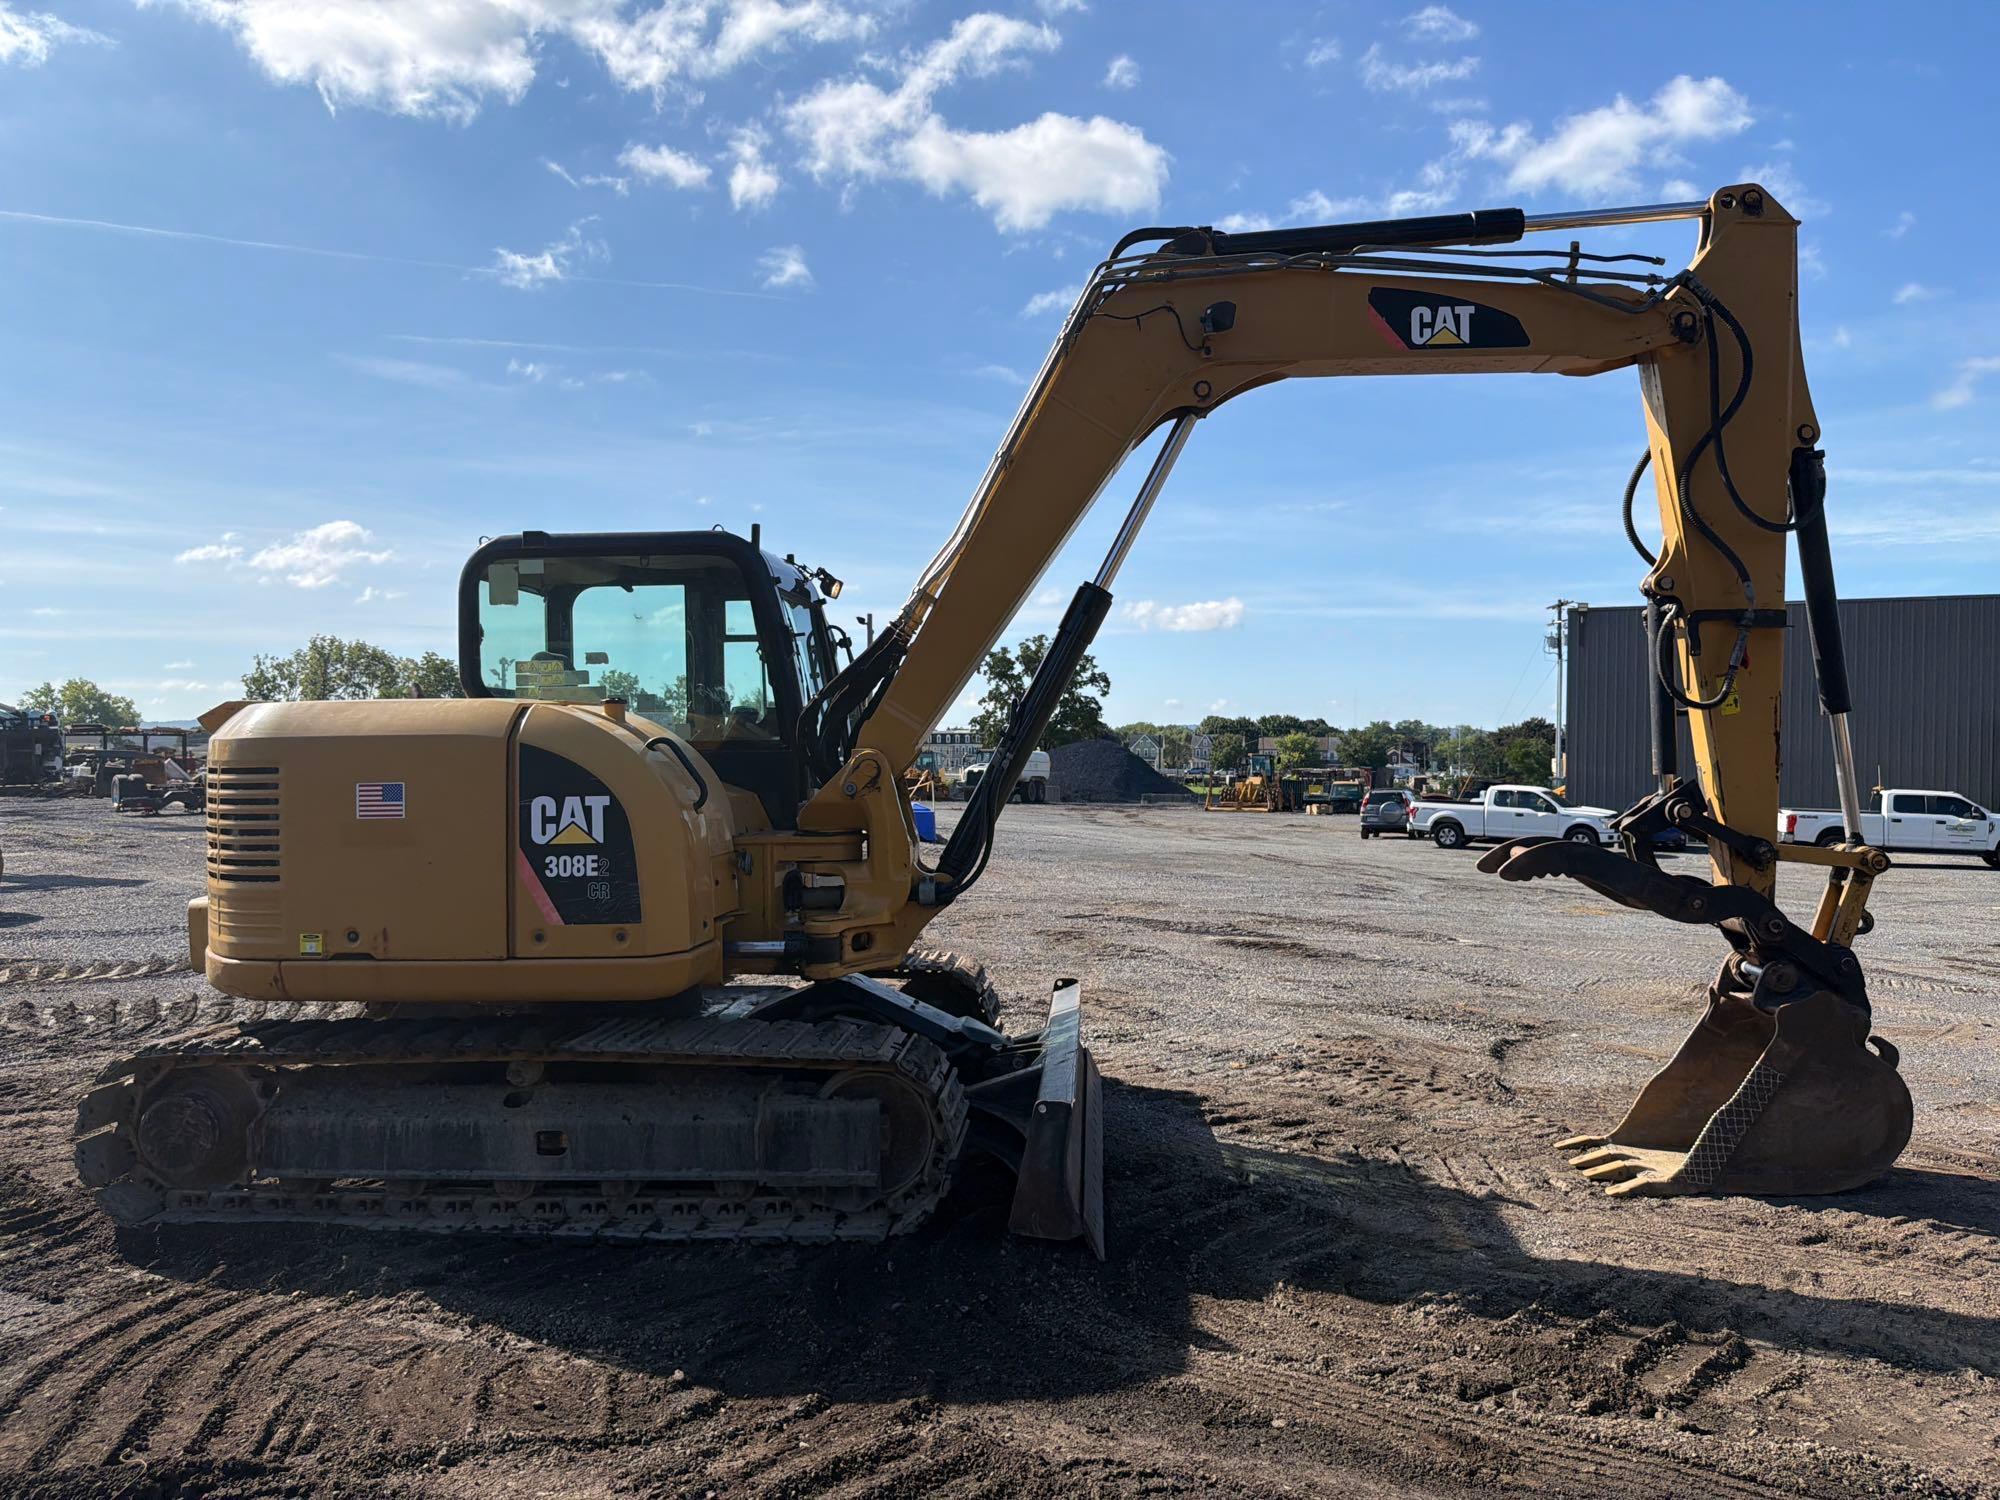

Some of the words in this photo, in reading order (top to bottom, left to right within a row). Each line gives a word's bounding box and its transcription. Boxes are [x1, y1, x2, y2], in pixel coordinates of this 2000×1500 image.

[1410, 305, 1475, 345] CAT
[531, 795, 610, 845] CAT
[544, 854, 610, 878] 308E2
[587, 881, 611, 899] CR
